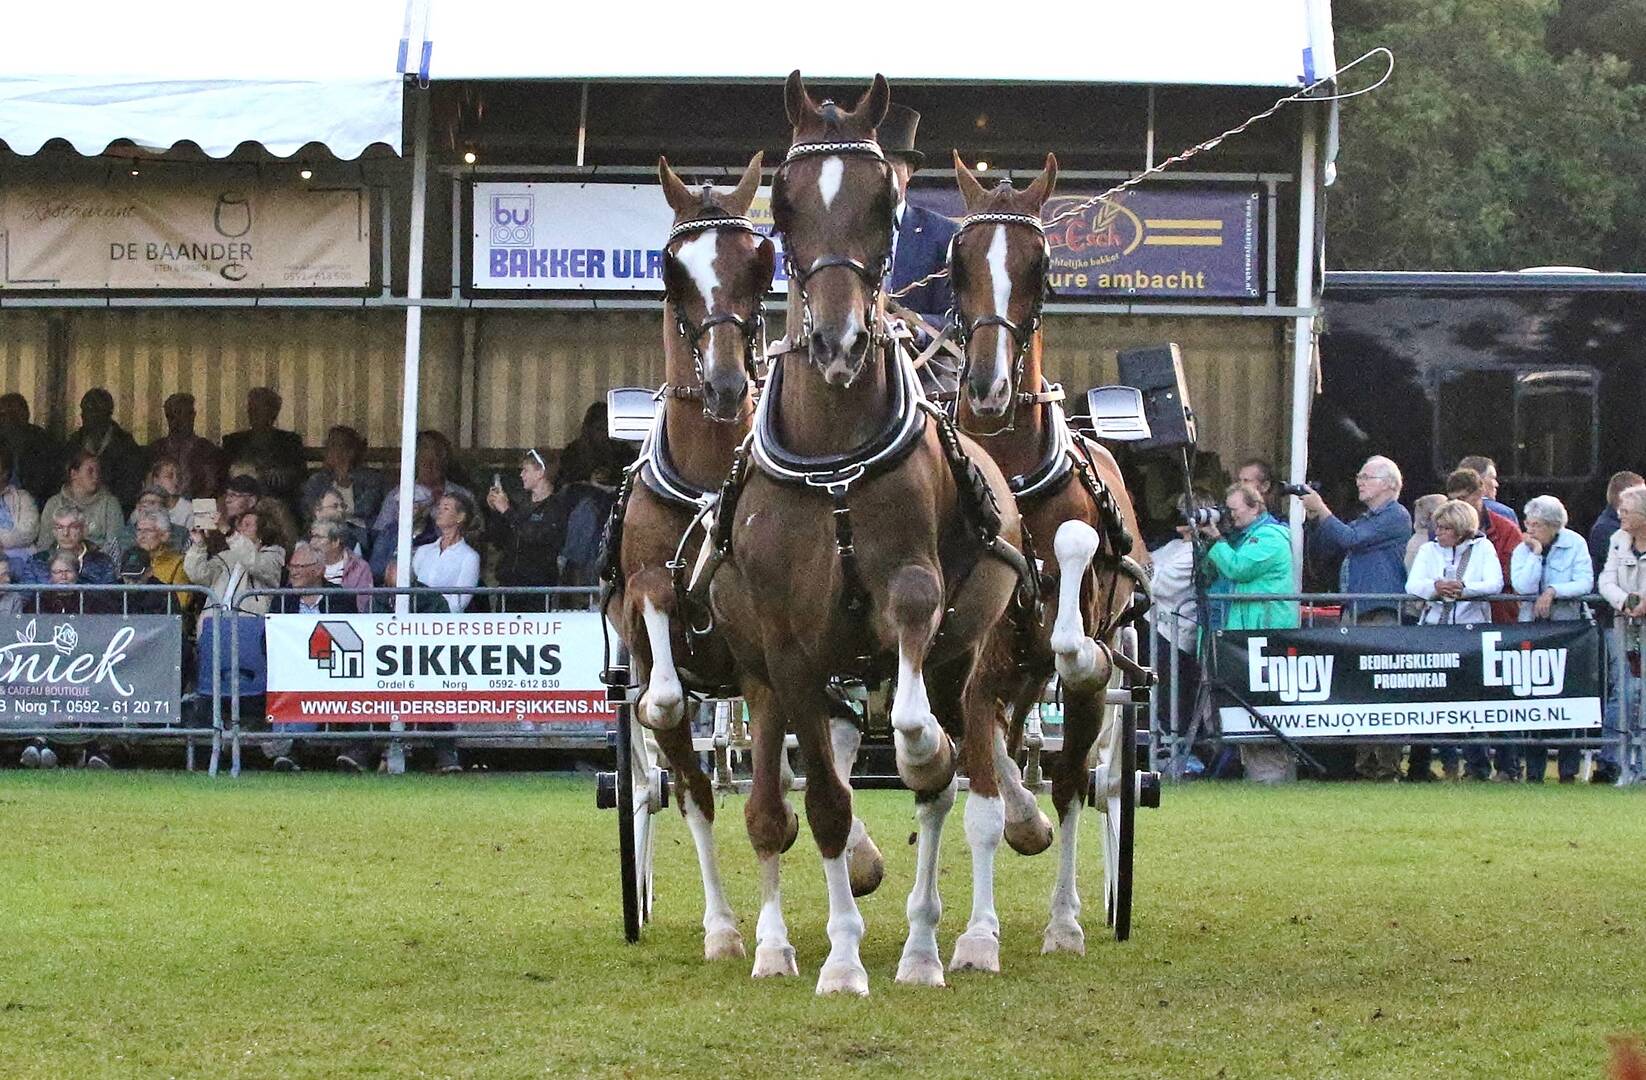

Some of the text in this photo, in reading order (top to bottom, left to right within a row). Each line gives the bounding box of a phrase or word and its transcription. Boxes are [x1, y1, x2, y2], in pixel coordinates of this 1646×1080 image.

[110, 243, 253, 260] DE BAANDER
[489, 249, 605, 278] BAKKER
[1099, 270, 1204, 289] ambacht
[376, 622, 562, 635] SCHILDERSBEDRIJF
[0, 627, 135, 696] niek
[376, 644, 562, 676] SIKKENS
[1248, 631, 1567, 702] Enjoy Enjoy
[1359, 652, 1460, 670] BEDRIJFSKLEDING
[377, 680, 406, 689] Ordel
[408, 680, 415, 689] 6
[442, 680, 468, 690] Norg
[520, 680, 539, 688] 612
[541, 680, 560, 688] 830
[1374, 673, 1447, 689] PROMOWEAR
[7, 686, 43, 696] CADEAU
[44, 686, 90, 697] BOUTIQUE
[14, 700, 48, 715] Norg
[51, 700, 62, 713] T.
[66, 701, 100, 713] 0592
[112, 701, 128, 713] 61
[133, 701, 150, 713] 20
[154, 701, 170, 713] 71
[301, 700, 615, 714] WWW.SCHILDERSBEDRIJFSIKKENS.NL
[1249, 707, 1571, 729] WWW.ENJOYBEDRIJFSKLEDING.NL
